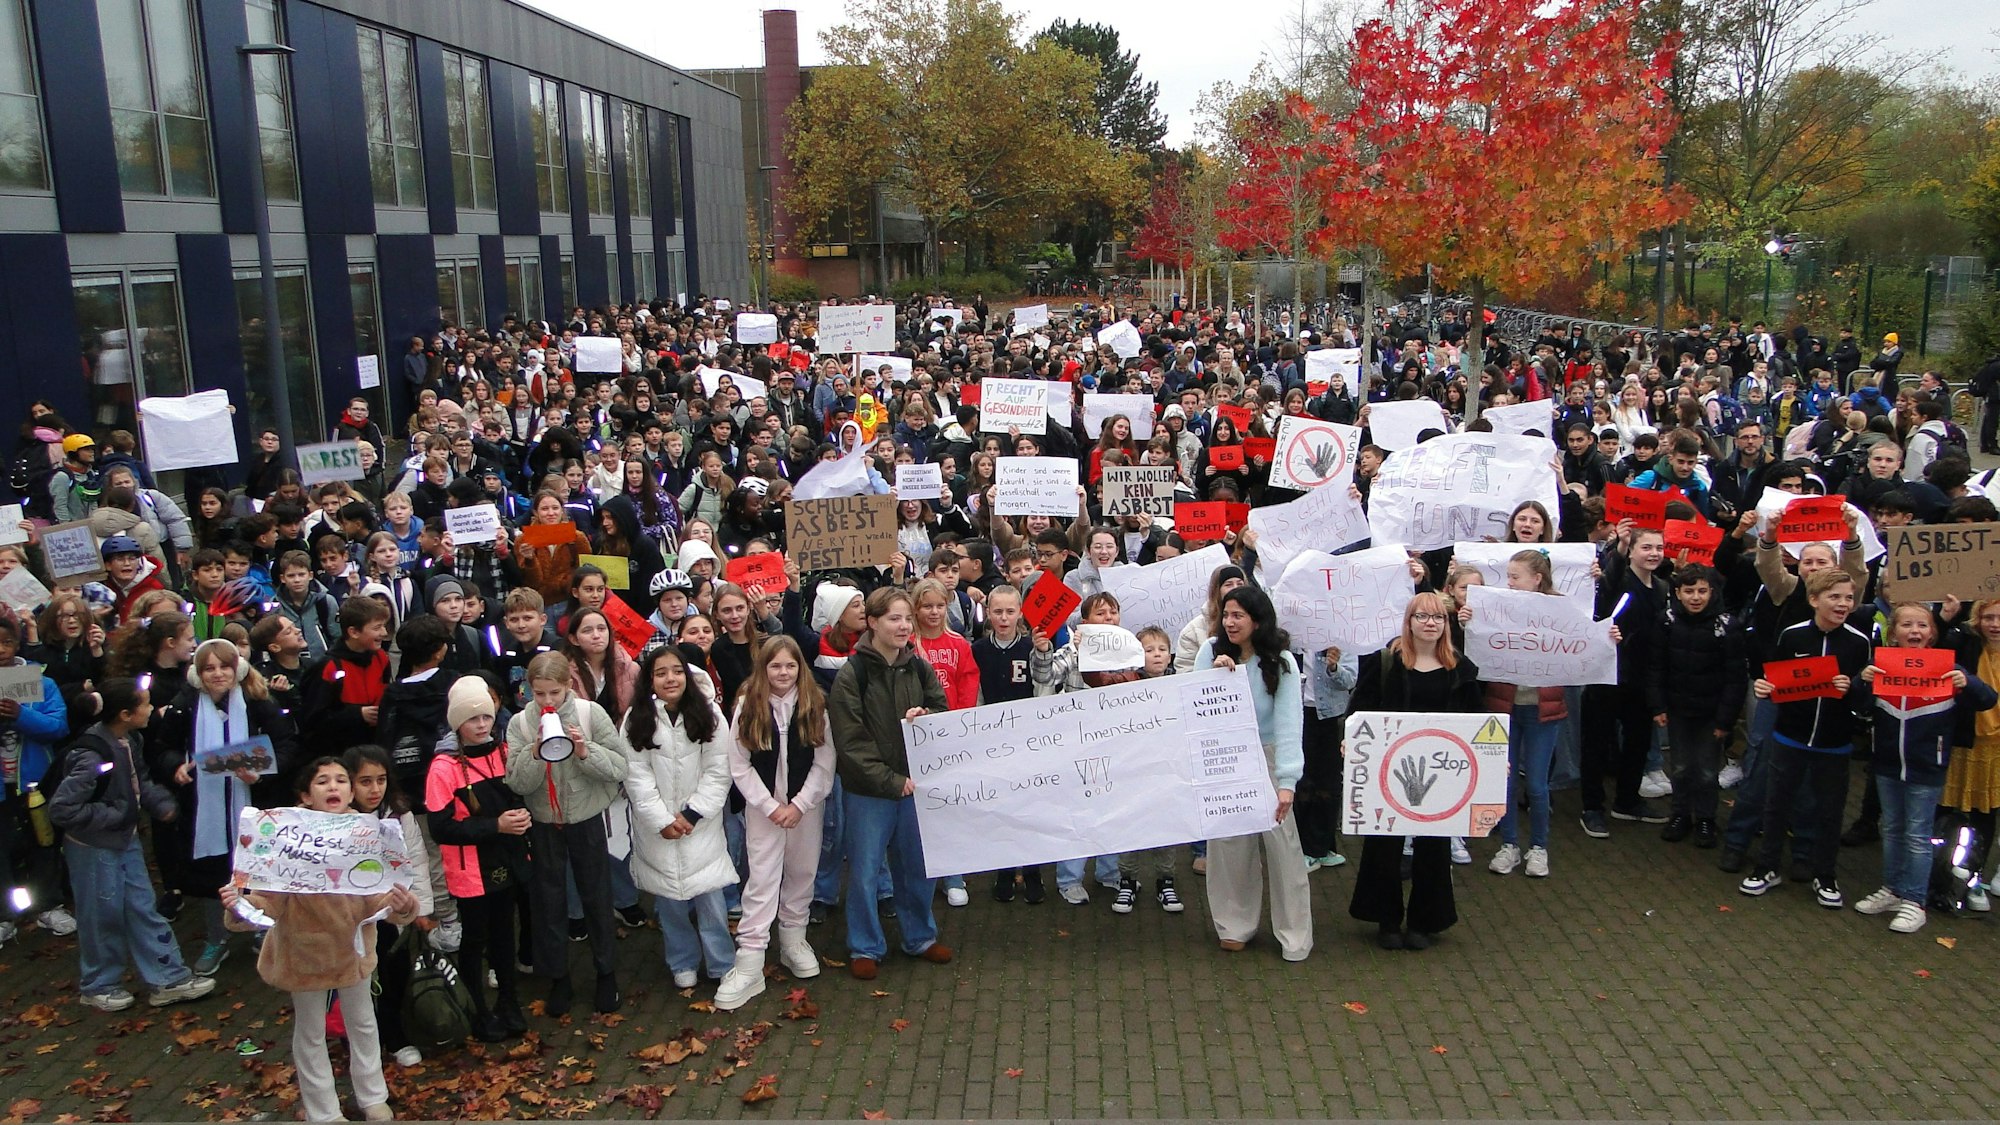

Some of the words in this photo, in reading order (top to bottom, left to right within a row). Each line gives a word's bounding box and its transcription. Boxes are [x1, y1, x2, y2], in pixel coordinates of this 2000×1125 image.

[996, 382, 1035, 396] RECHT
[1004, 395, 1027, 405] AUF
[984, 402, 1043, 417] GESUNDHEIT
[1219, 452, 1234, 461] ES
[1002, 465, 1027, 474] Kinder
[1107, 471, 1132, 483] WIR
[1136, 470, 1174, 483] WOLLEN
[1124, 483, 1154, 498] KEIN
[793, 497, 870, 516] SCHULE
[1108, 496, 1173, 516] ASBEST
[1623, 495, 1641, 506] ES
[452, 512, 473, 520] Asbest
[1193, 510, 1206, 518] ES
[1800, 506, 1819, 515] ES
[791, 510, 879, 539] ASBEST
[1179, 524, 1221, 533] REICHT!
[1262, 513, 1290, 537] ES
[1782, 521, 1840, 534] REICHT!
[1684, 530, 1700, 540] ES
[1895, 529, 2000, 557] ASBEST-
[798, 547, 845, 570] PEST
[852, 544, 871, 564] !!!
[747, 564, 763, 572] ES
[1159, 555, 1210, 591] GEHT
[1896, 560, 1933, 581] LOS
[1034, 592, 1047, 609] ES
[1152, 595, 1174, 614] UM
[1038, 592, 1071, 632] REICHT!
[1280, 594, 1367, 625] UNSERE
[618, 614, 633, 628] ES
[1480, 599, 1518, 623] WIR
[1526, 610, 1596, 641] WOLLEN
[1488, 632, 1587, 655] GESUND
[1904, 658, 1924, 668] ES
[1011, 660, 1027, 683] E
[1792, 668, 1812, 679] ES
[1882, 676, 1946, 688] REICHT!
[1201, 685, 1228, 696] HMG
[1192, 693, 1243, 709] AS-BESTE
[911, 723, 950, 747] Die
[958, 708, 1023, 738] Stadt
[1036, 697, 1087, 722] würde
[1098, 688, 1165, 712] handeln,
[1196, 705, 1239, 718] SCHULE
[1200, 738, 1220, 747] KEIN
[920, 751, 973, 776] wenn
[986, 741, 1015, 759] es
[1026, 731, 1064, 751] eine
[1202, 745, 1248, 758] (AS)BESTER
[1203, 757, 1219, 766] ORT
[1220, 755, 1239, 764] ZUM
[1429, 751, 1470, 777] Stop
[1204, 766, 1236, 777] LERNEN
[1348, 720, 1376, 835] ASBEST
[926, 781, 998, 811] Schule
[1010, 772, 1061, 791] wäre
[1203, 792, 1233, 803] Wissen
[1235, 789, 1259, 799] statt
[1205, 804, 1256, 818] (as)Bestien.
[277, 863, 327, 888] Weg
